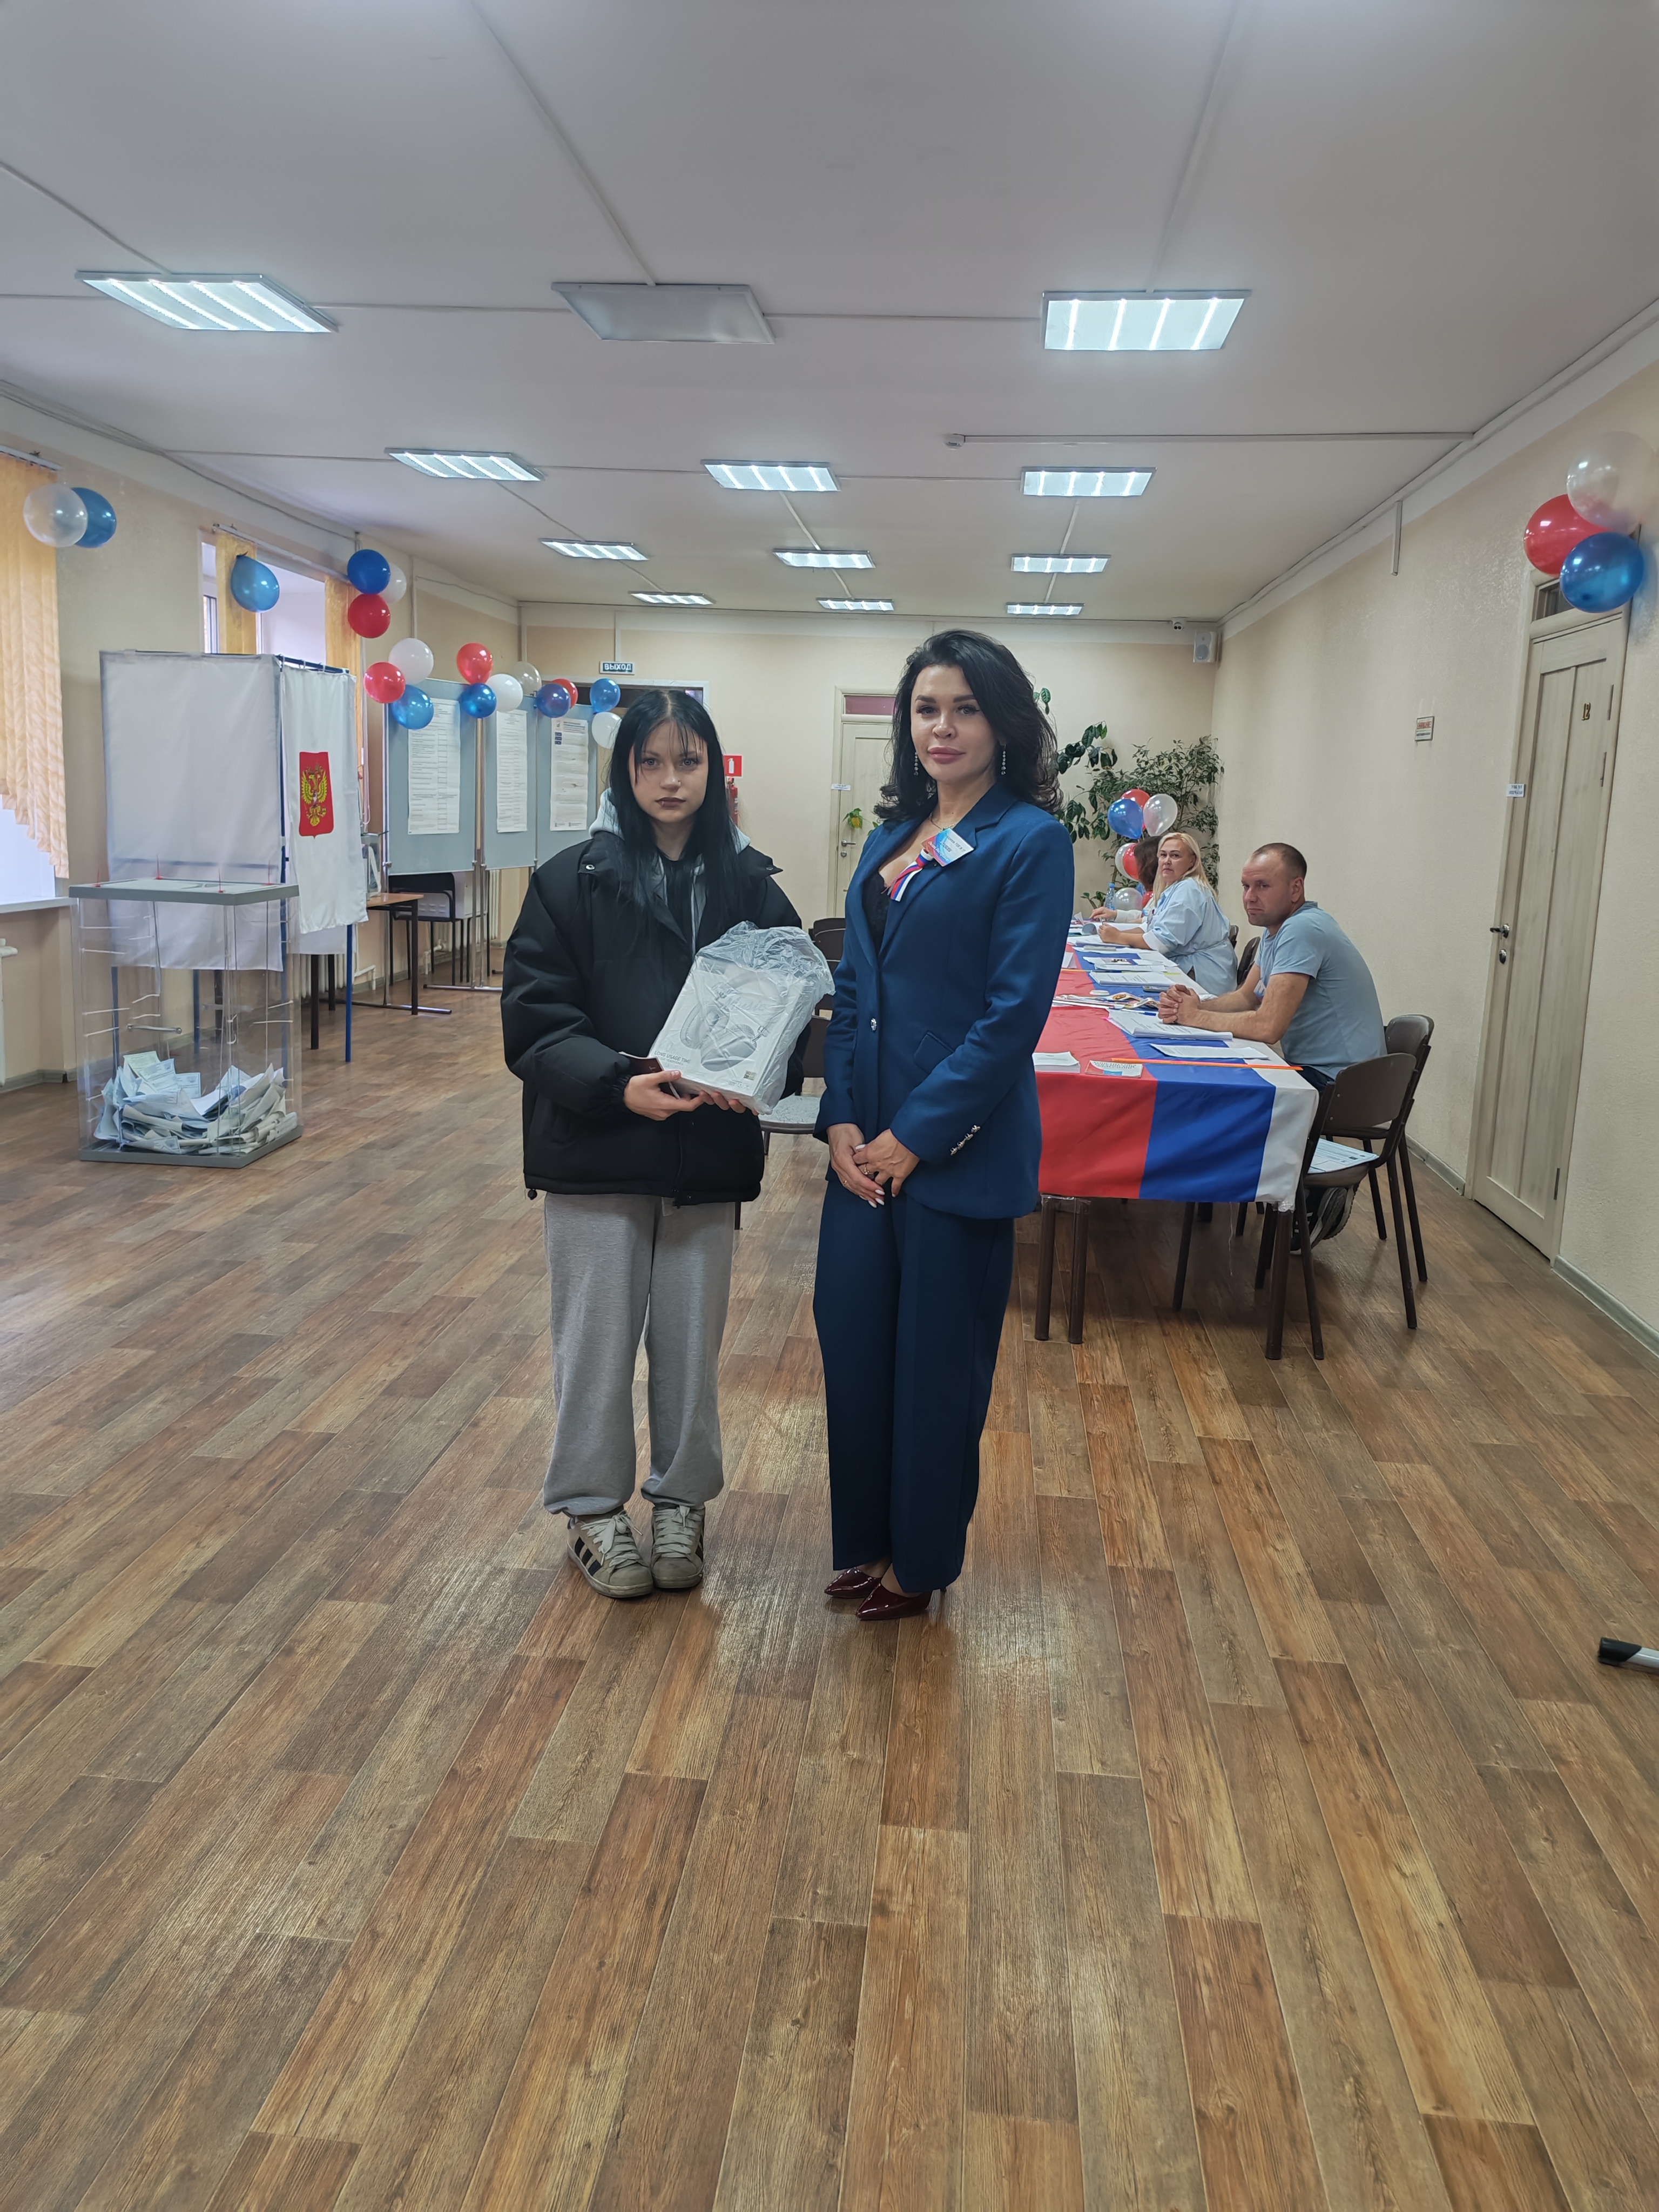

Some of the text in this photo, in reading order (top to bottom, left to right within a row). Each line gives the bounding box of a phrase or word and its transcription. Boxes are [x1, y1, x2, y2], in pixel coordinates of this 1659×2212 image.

[604, 663, 631, 672] ВЫХОД
[1581, 702, 1591, 721] 12
[666, 1054, 682, 1062] USAGE
